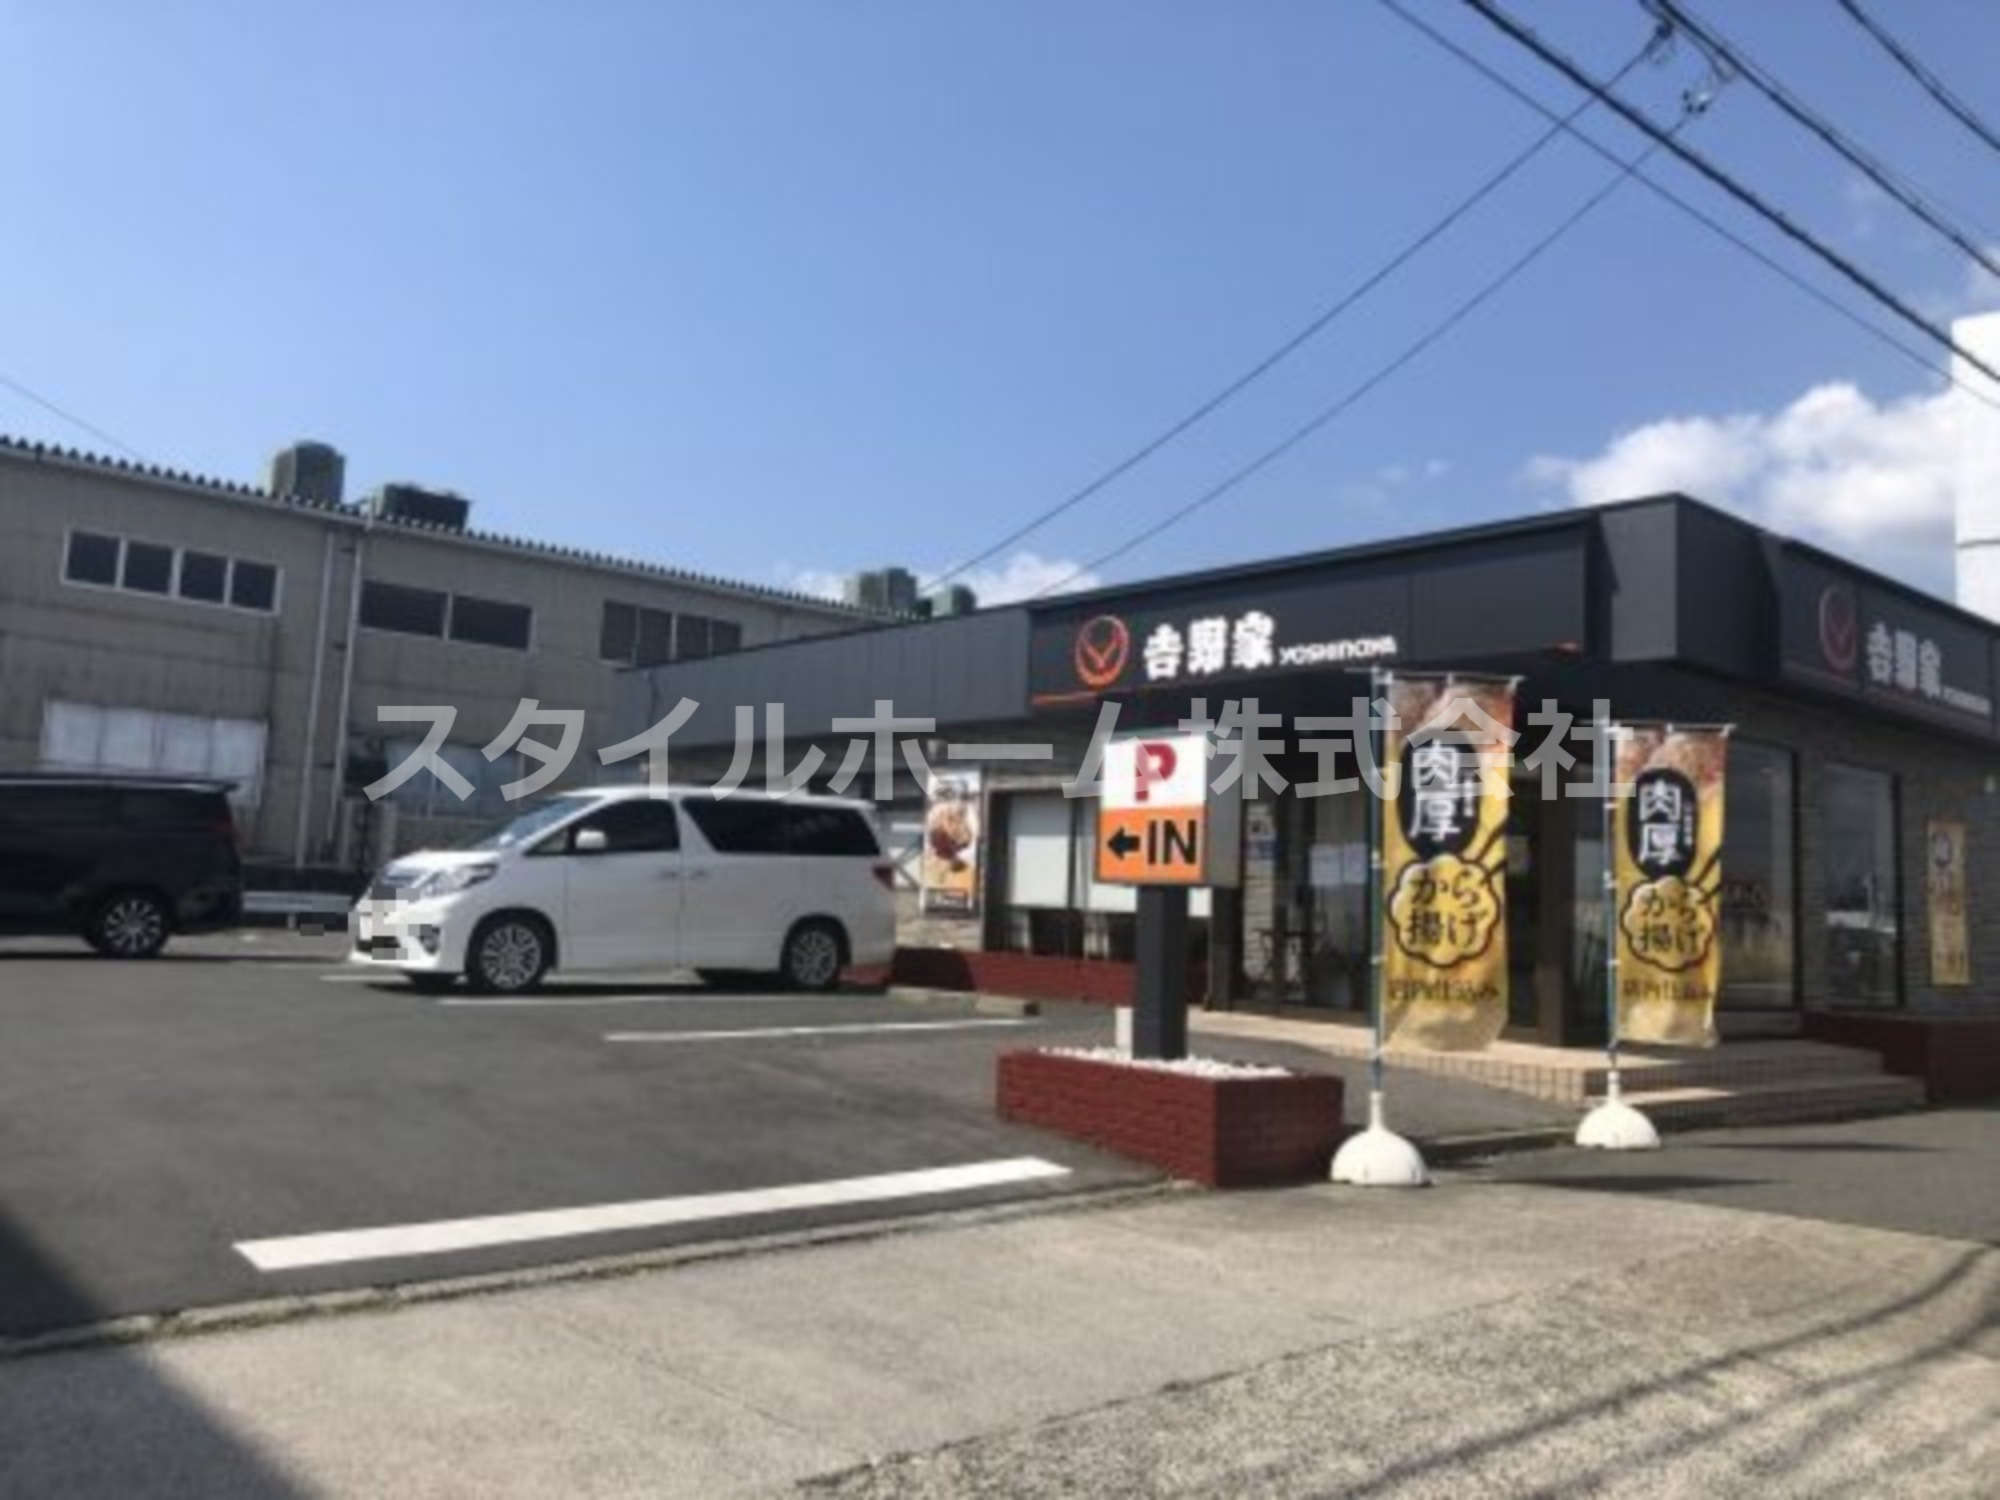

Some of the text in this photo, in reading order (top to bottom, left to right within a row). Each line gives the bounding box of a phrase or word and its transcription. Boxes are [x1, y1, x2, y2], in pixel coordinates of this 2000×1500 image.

[1135, 741, 1177, 801] P
[1409, 737, 1463, 842] 肉厚
[1147, 819, 1197, 865] IN
[1638, 779, 1682, 866] 肉厚
